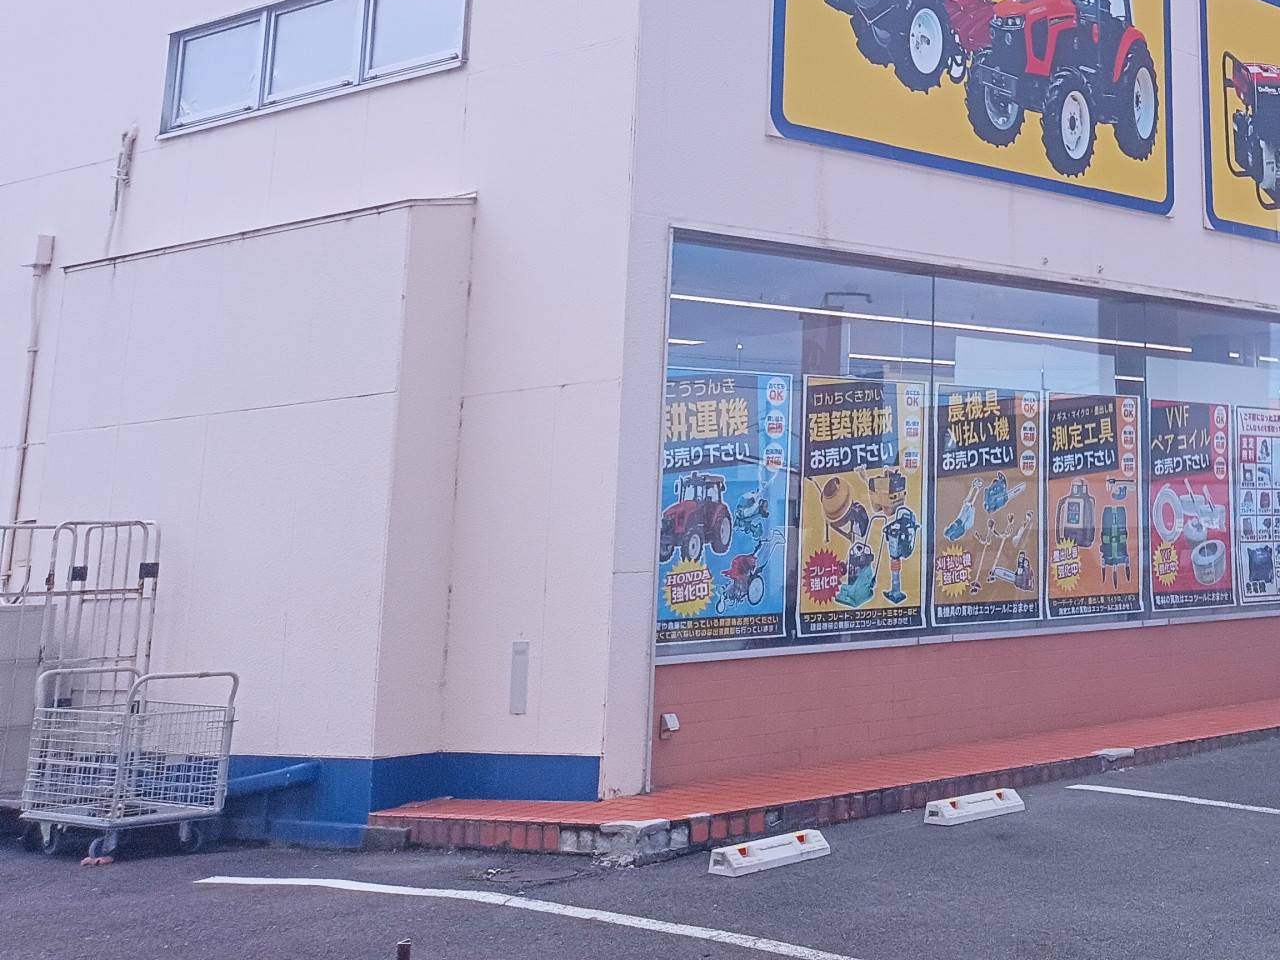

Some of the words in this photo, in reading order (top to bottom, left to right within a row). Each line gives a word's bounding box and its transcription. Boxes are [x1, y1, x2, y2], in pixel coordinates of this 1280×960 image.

[769, 390, 784, 400] OK
[813, 389, 884, 406] けんちくきかい
[906, 396, 919, 406] OK
[947, 389, 1001, 422] 農機具
[1023, 404, 1035, 413] OK
[1123, 409, 1134, 418] OK
[1165, 405, 1189, 430] VVF
[809, 405, 893, 442] 建築機械
[947, 416, 1010, 447] 刈払い機
[1052, 418, 1114, 452] 測定工具
[1151, 427, 1211, 454] ペアコイル
[664, 442, 750, 468] お売り下さい
[810, 443, 894, 469] お売り下さい
[942, 446, 1014, 471] お売り下さい
[1052, 449, 1115, 474] お売り下さい
[1154, 452, 1210, 476] お売り下さい
[667, 570, 711, 586] HONDA
[810, 575, 838, 592] 強化中
[943, 568, 968, 585] 強化中
[671, 582, 709, 603] 強化中
